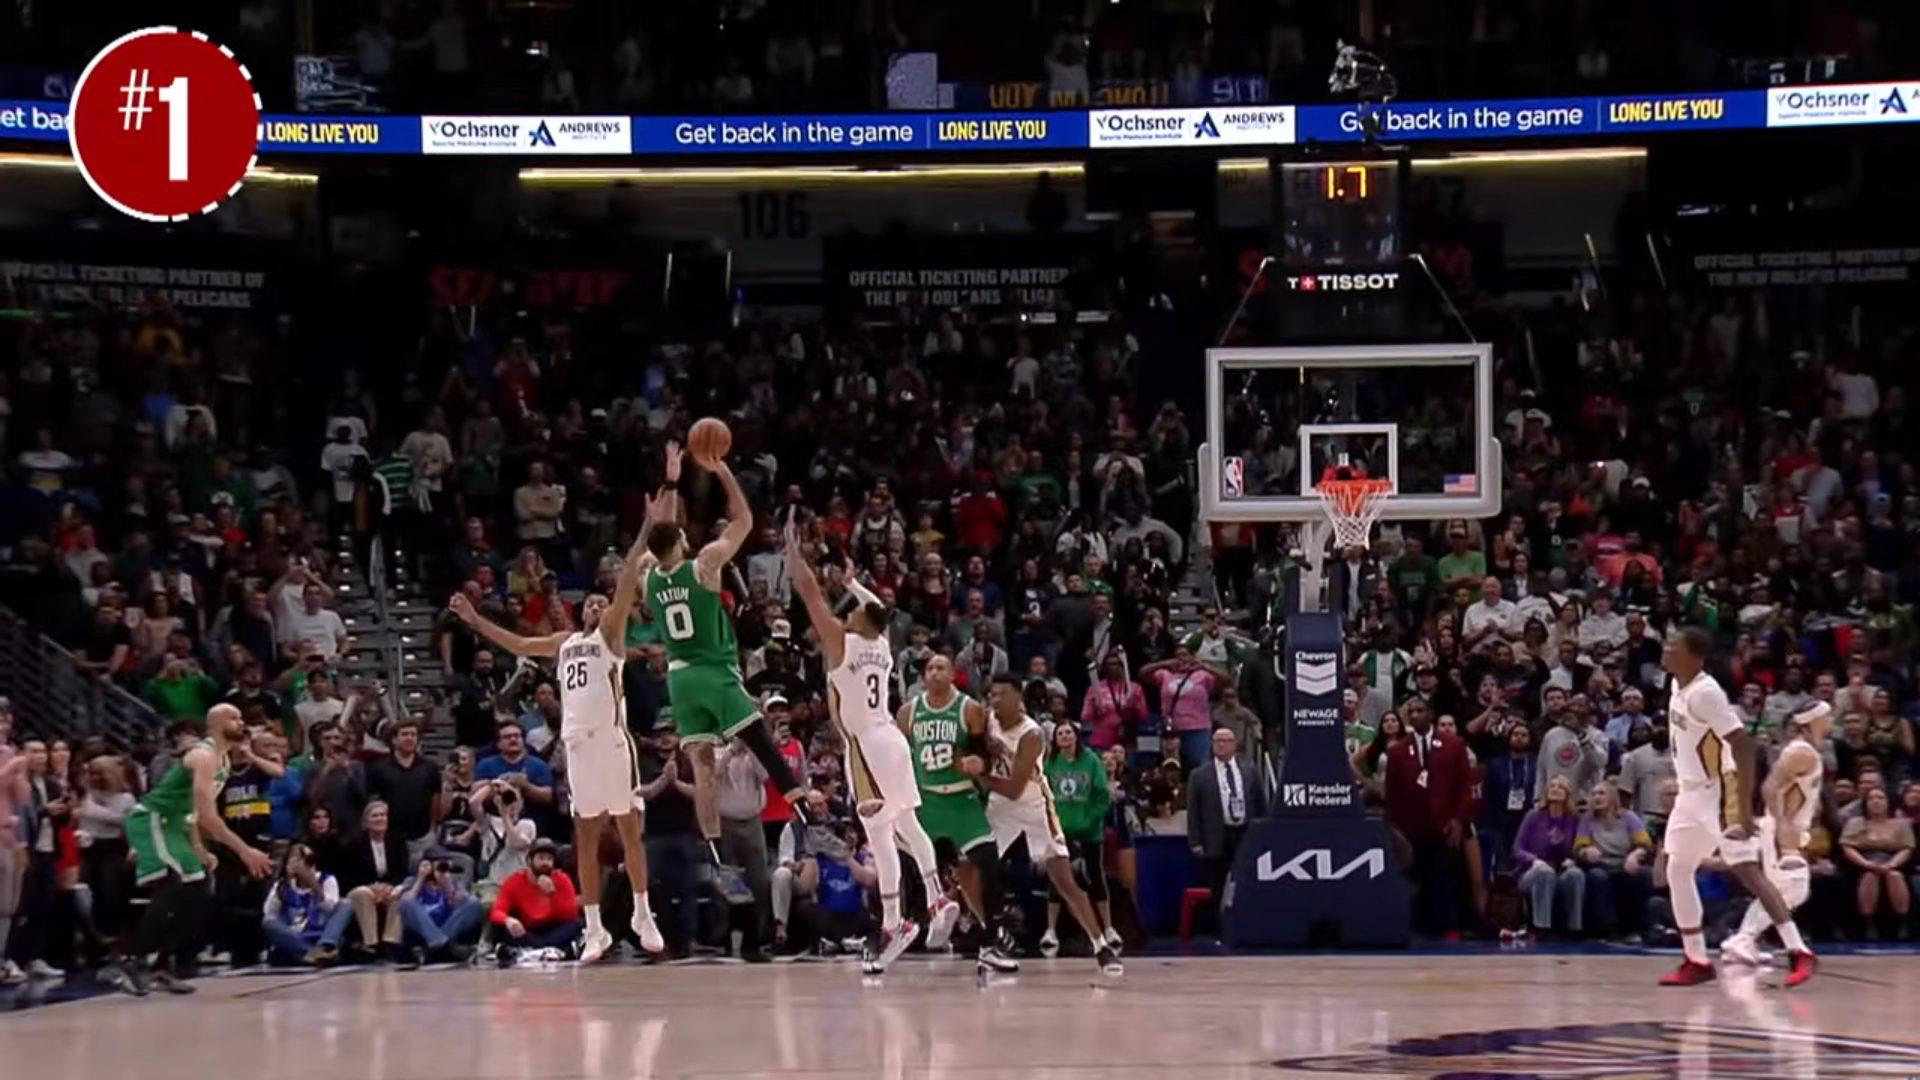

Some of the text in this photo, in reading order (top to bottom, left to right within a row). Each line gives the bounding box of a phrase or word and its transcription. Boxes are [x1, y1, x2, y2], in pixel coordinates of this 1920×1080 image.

[1788, 91, 1870, 109] Ochsner
[1223, 111, 1285, 124] ANDREWS
[1386, 108, 1443, 131] back
[1448, 106, 1468, 130] in
[1473, 105, 1512, 129] the
[1516, 107, 1584, 131] game
[1609, 98, 1724, 123] LONG LIVE YOU
[441, 120, 520, 138] Ochsner
[558, 121, 621, 134] ANDREWS
[938, 119, 1047, 142] LONG LIVE YOU
[1107, 114, 1186, 131] Ochsner
[267, 122, 380, 145] LONG LIVE YOU
[675, 120, 914, 146] Get back in the game
[1325, 165, 1369, 200] 1.7
[849, 270, 917, 287] OFFICIAL
[920, 269, 998, 286] TICKETING
[1317, 273, 1400, 290] TISSOT
[863, 289, 894, 306] THE
[656, 587, 690, 605] TATUM
[665, 602, 694, 640] 0
[1295, 650, 1337, 660] Chevron
[566, 661, 588, 691] 25
[866, 673, 880, 709] 3
[1293, 708, 1339, 719] NEWAGE
[912, 720, 958, 742] BOSTON
[920, 743, 954, 772] 42
[1308, 782, 1351, 794] Keesler
[1308, 794, 1351, 806] Federal
[1257, 848, 1384, 880] KIA
